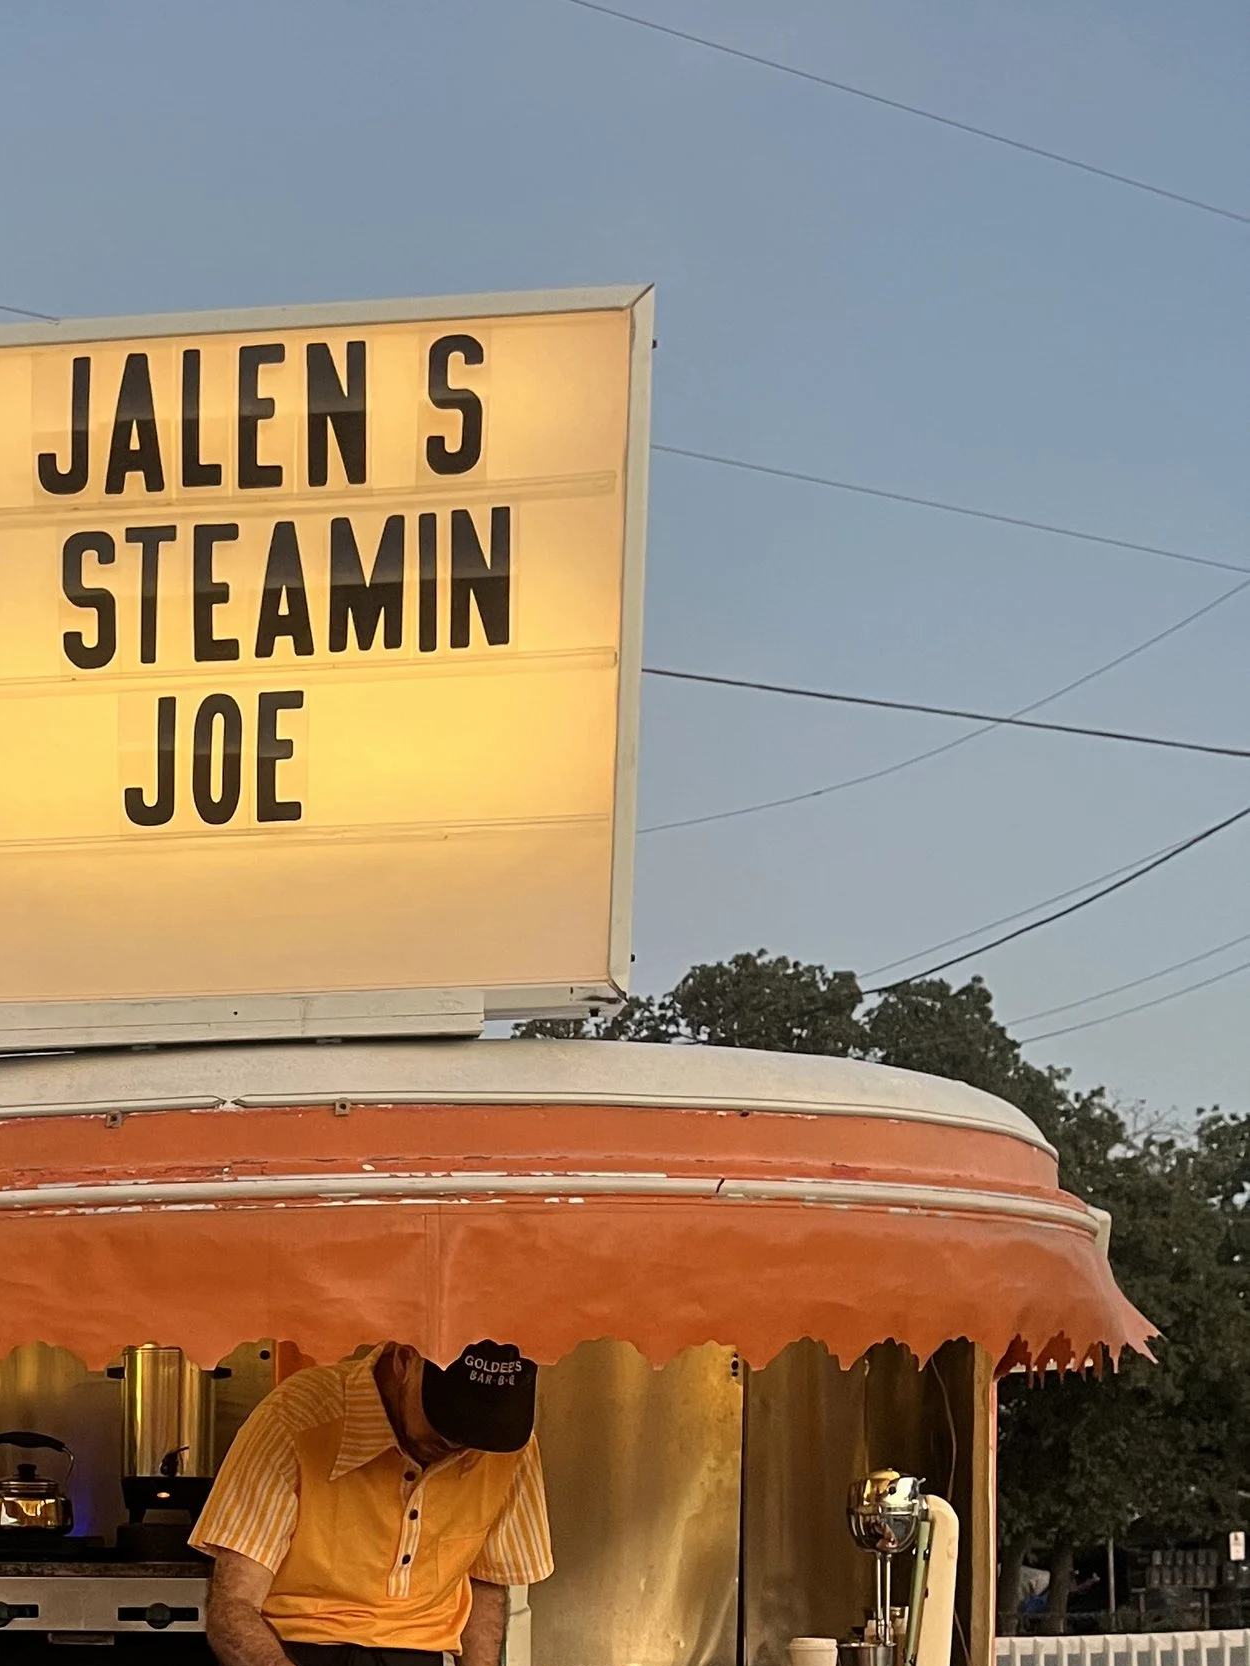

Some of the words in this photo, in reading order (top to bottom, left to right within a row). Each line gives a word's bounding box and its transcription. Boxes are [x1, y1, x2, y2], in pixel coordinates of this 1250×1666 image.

[38, 340, 367, 495] JALEN
[426, 334, 484, 475] S
[62, 506, 511, 669] STEAMIN
[124, 690, 304, 827] JOE
